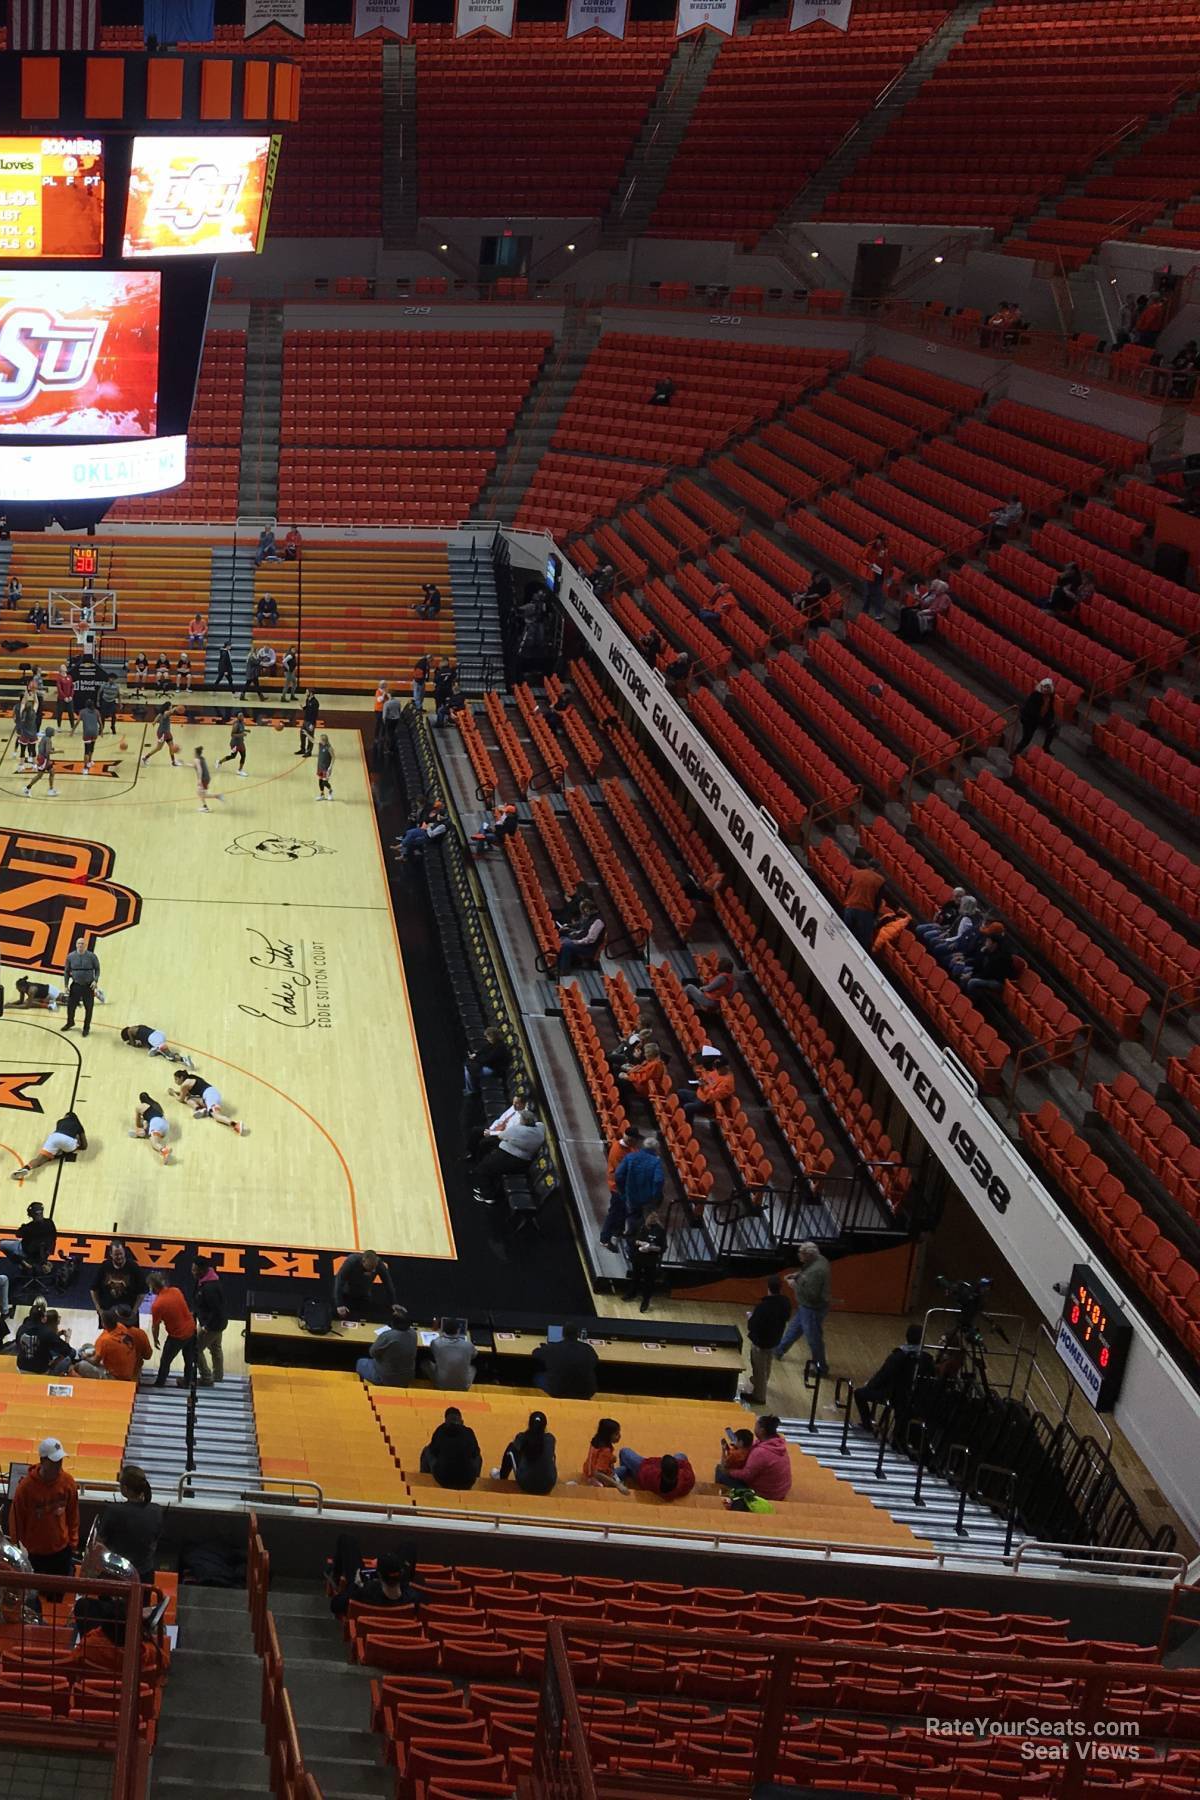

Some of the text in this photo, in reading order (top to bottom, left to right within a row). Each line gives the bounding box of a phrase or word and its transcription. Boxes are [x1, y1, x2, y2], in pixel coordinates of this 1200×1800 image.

[63, 157, 78, 172] 0
[84, 176, 101, 186] PT
[264, 139, 279, 210] Hertz
[404, 306, 432, 315] 219
[710, 315, 742, 325] 220
[75, 557, 95, 572] 30
[568, 588, 1012, 1216] WELCOME TO HISTORIC GALLAGHER-IBA ARENA DEDICATED 1938
[312, 941, 332, 1028] EDDIE SUTTON COURT
[1071, 1305, 1081, 1324] 0
[1084, 1327, 1092, 1341] 1
[1059, 1328, 1100, 1392] HOMELAND
[1099, 1347, 1110, 1367] 0
